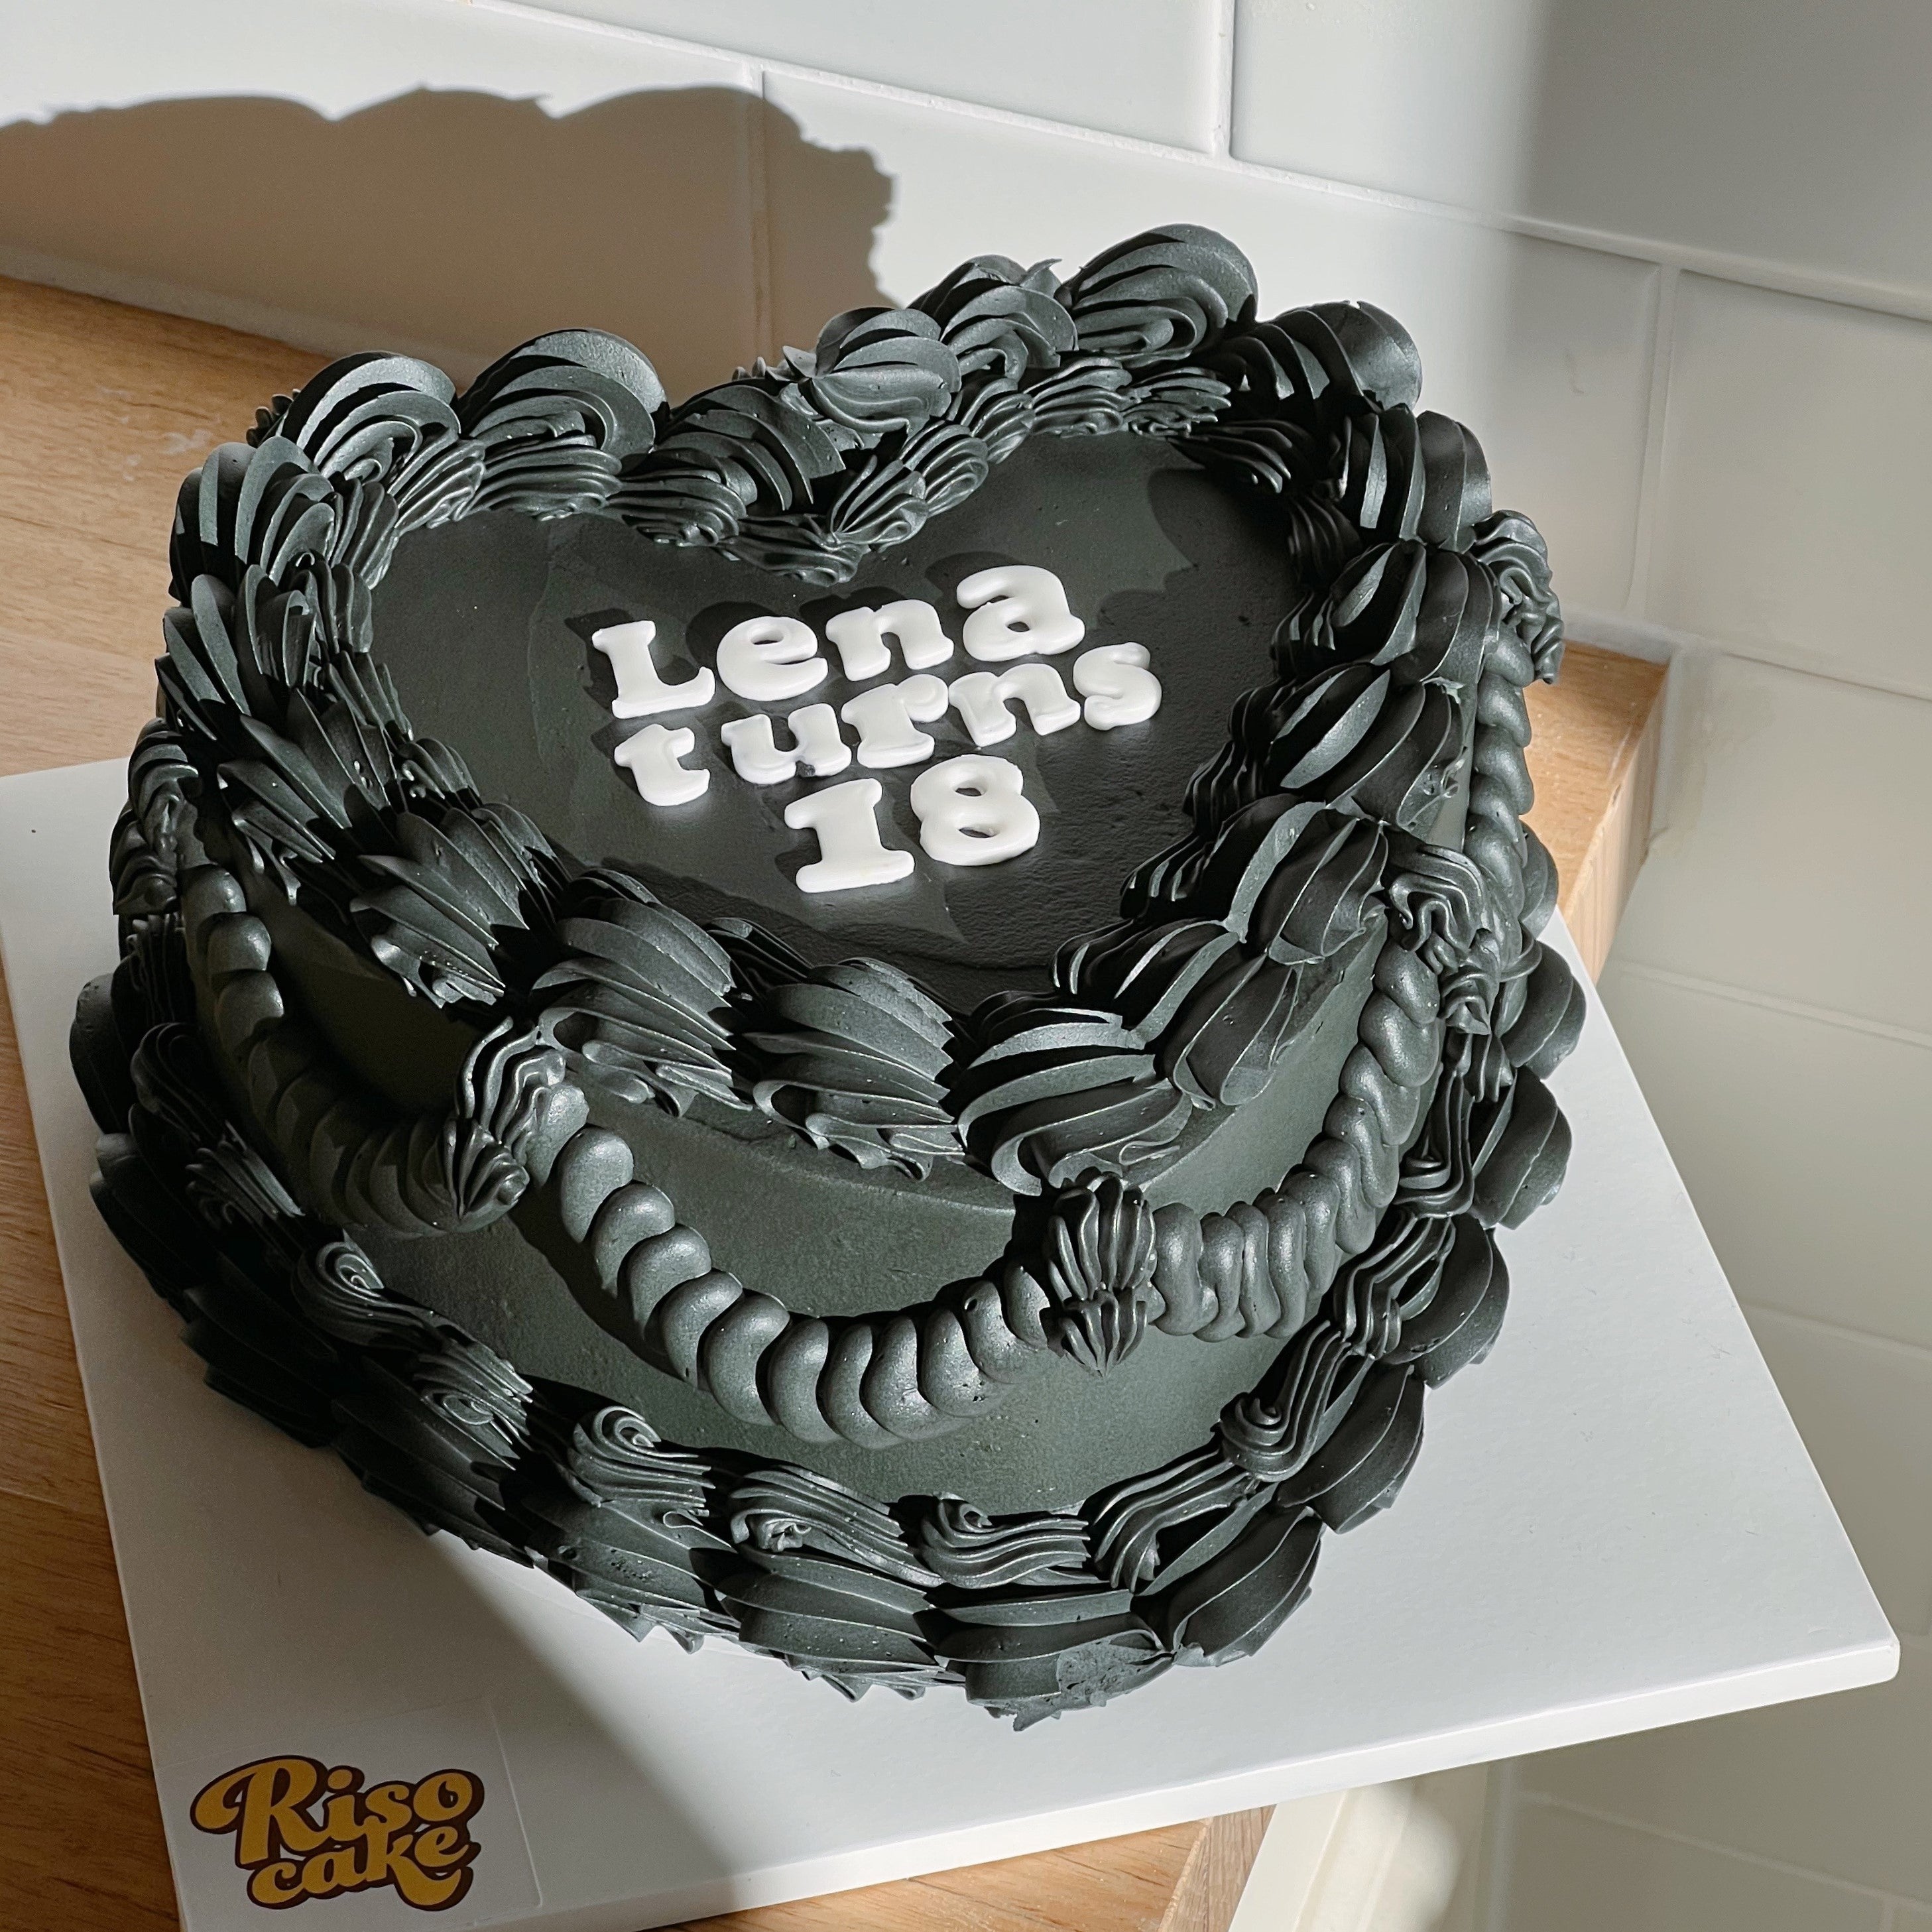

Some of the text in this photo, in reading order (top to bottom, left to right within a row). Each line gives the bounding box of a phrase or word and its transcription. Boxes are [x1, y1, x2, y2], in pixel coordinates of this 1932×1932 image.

[592, 566, 1085, 719] Lena
[615, 642, 1162, 807] turns
[784, 754, 1040, 893] 18
[190, 1755, 485, 1870] Riso
[247, 1817, 481, 1911] cake
